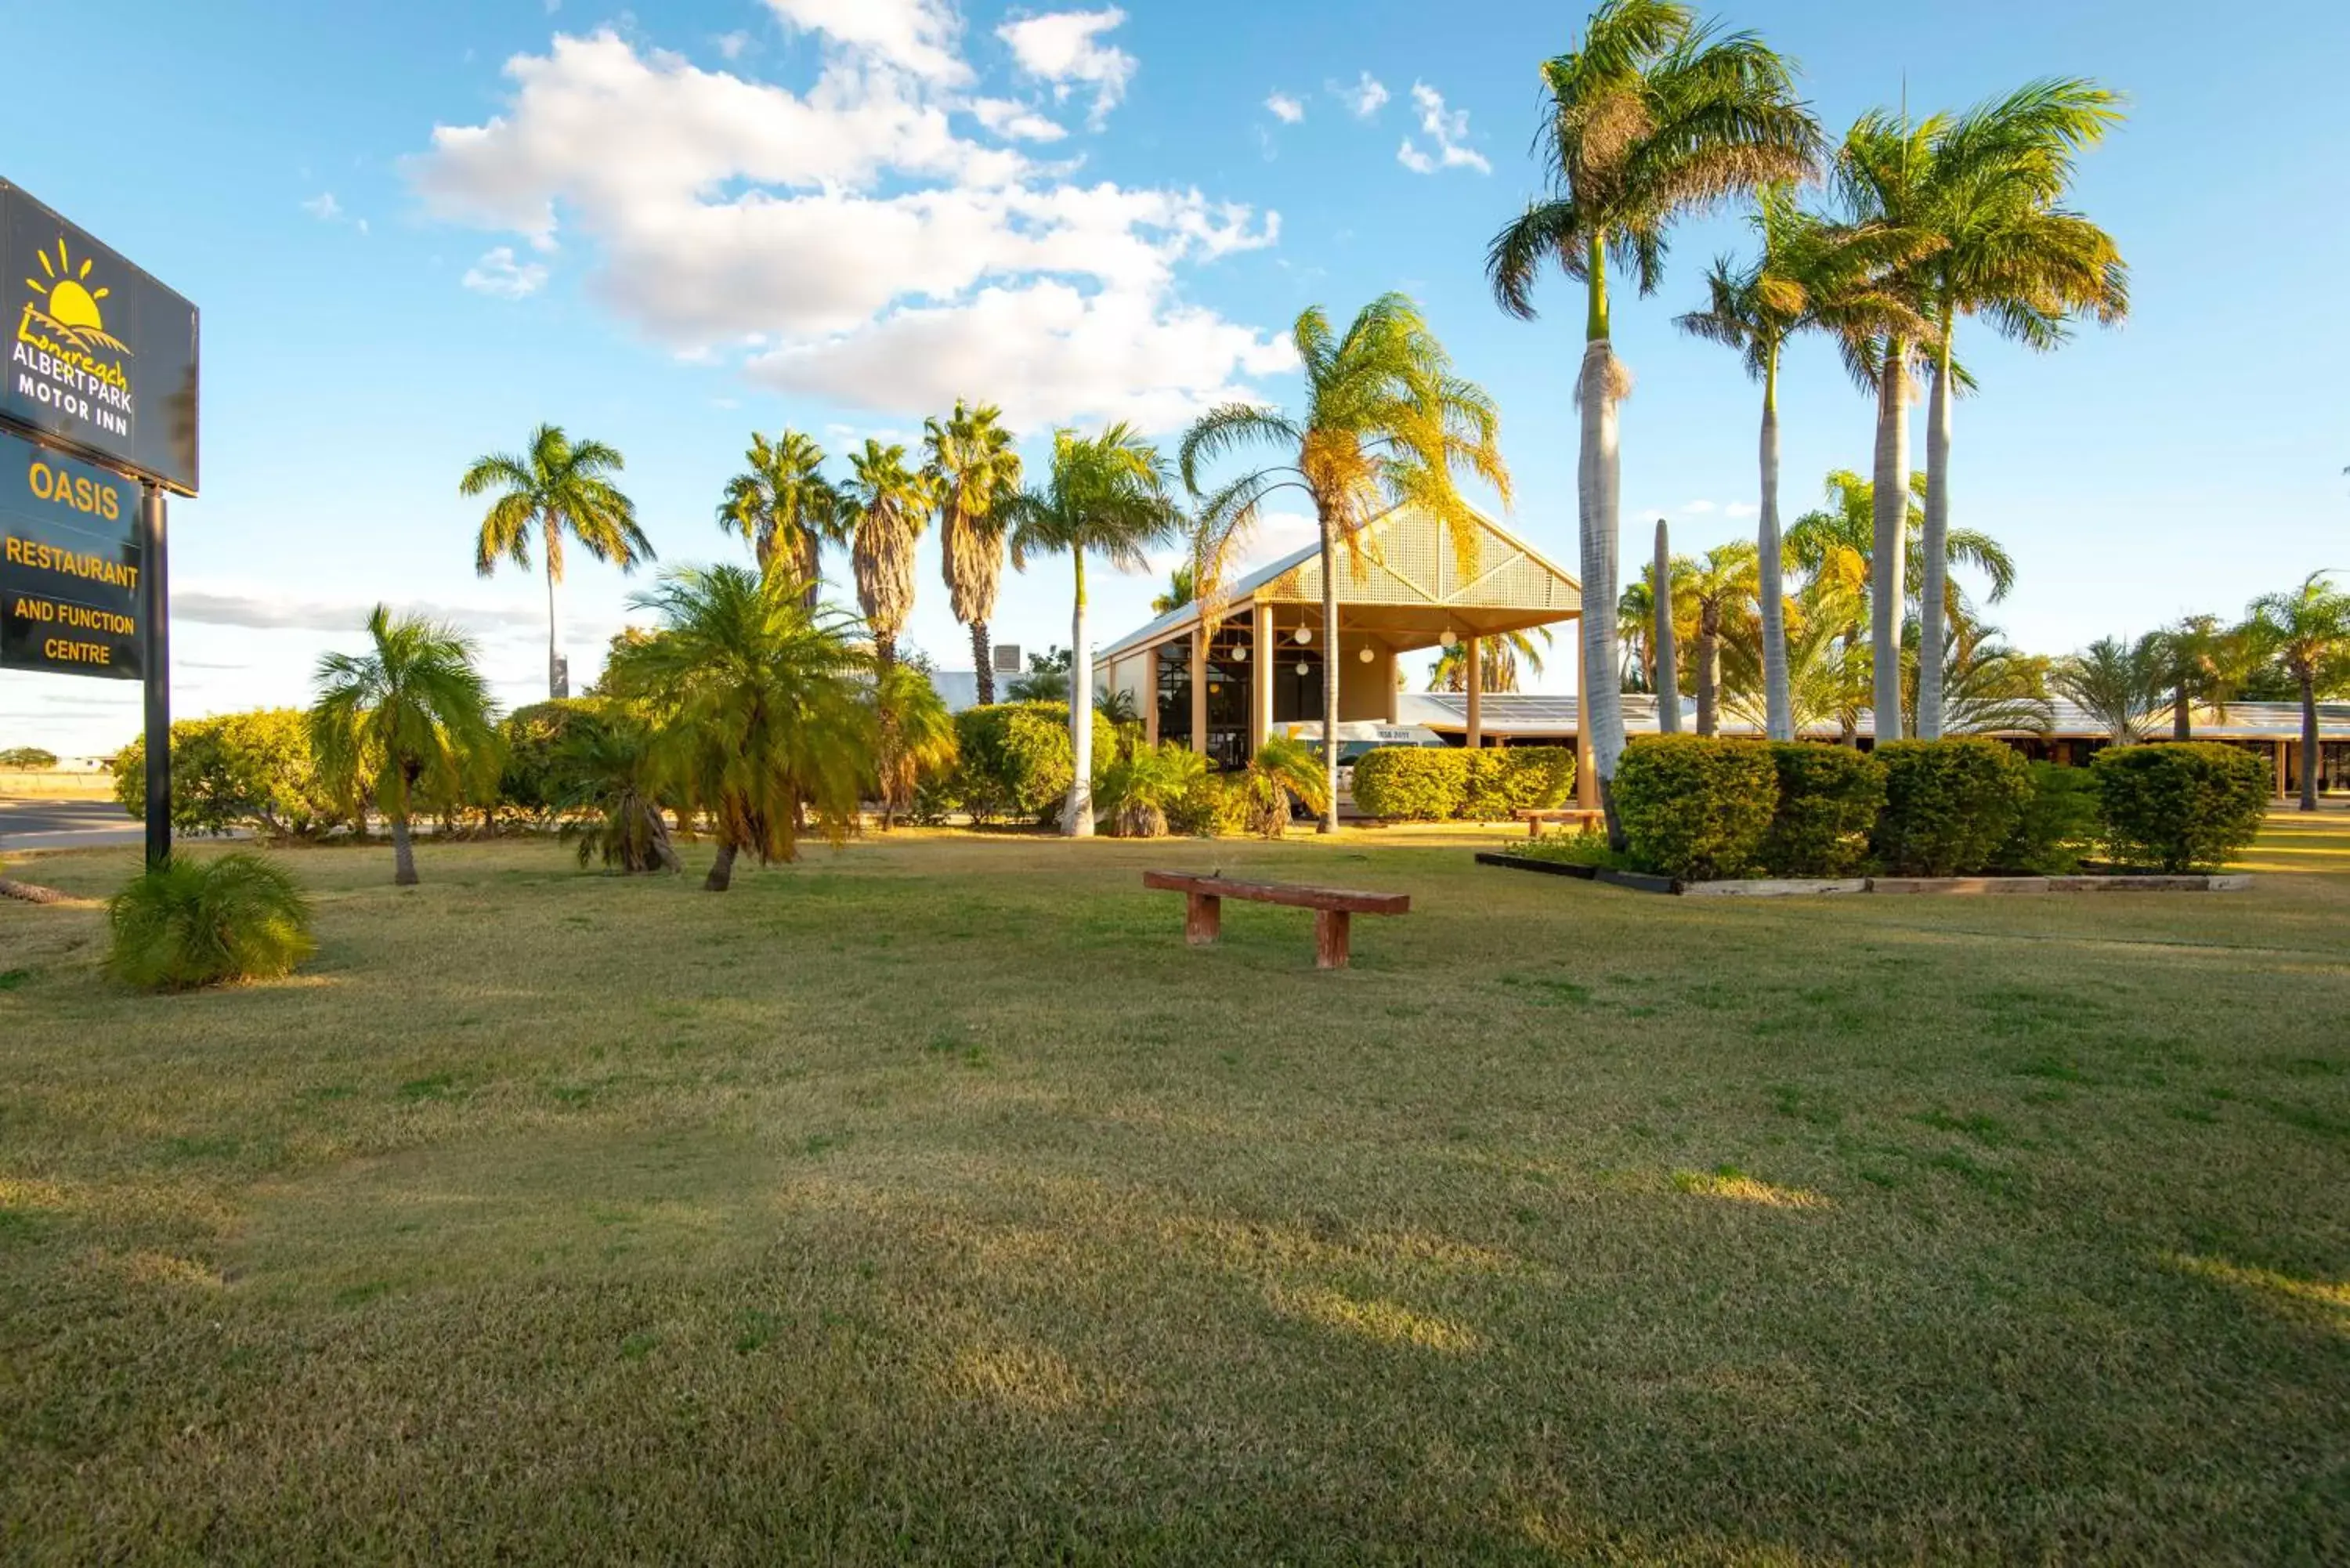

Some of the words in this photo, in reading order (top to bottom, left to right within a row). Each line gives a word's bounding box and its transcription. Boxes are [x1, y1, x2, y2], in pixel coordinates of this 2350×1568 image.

[17, 302, 127, 390] Longreach
[13, 341, 85, 391] ALBERT
[89, 376, 132, 414] PARK
[19, 374, 89, 421] MOTOR
[96, 407, 126, 436] INN
[29, 462, 119, 520] OASIS
[5, 537, 138, 589] RESTAURANT
[15, 598, 53, 620] AND
[59, 607, 134, 635] FUNCTION
[45, 638, 110, 663] CENTRE
